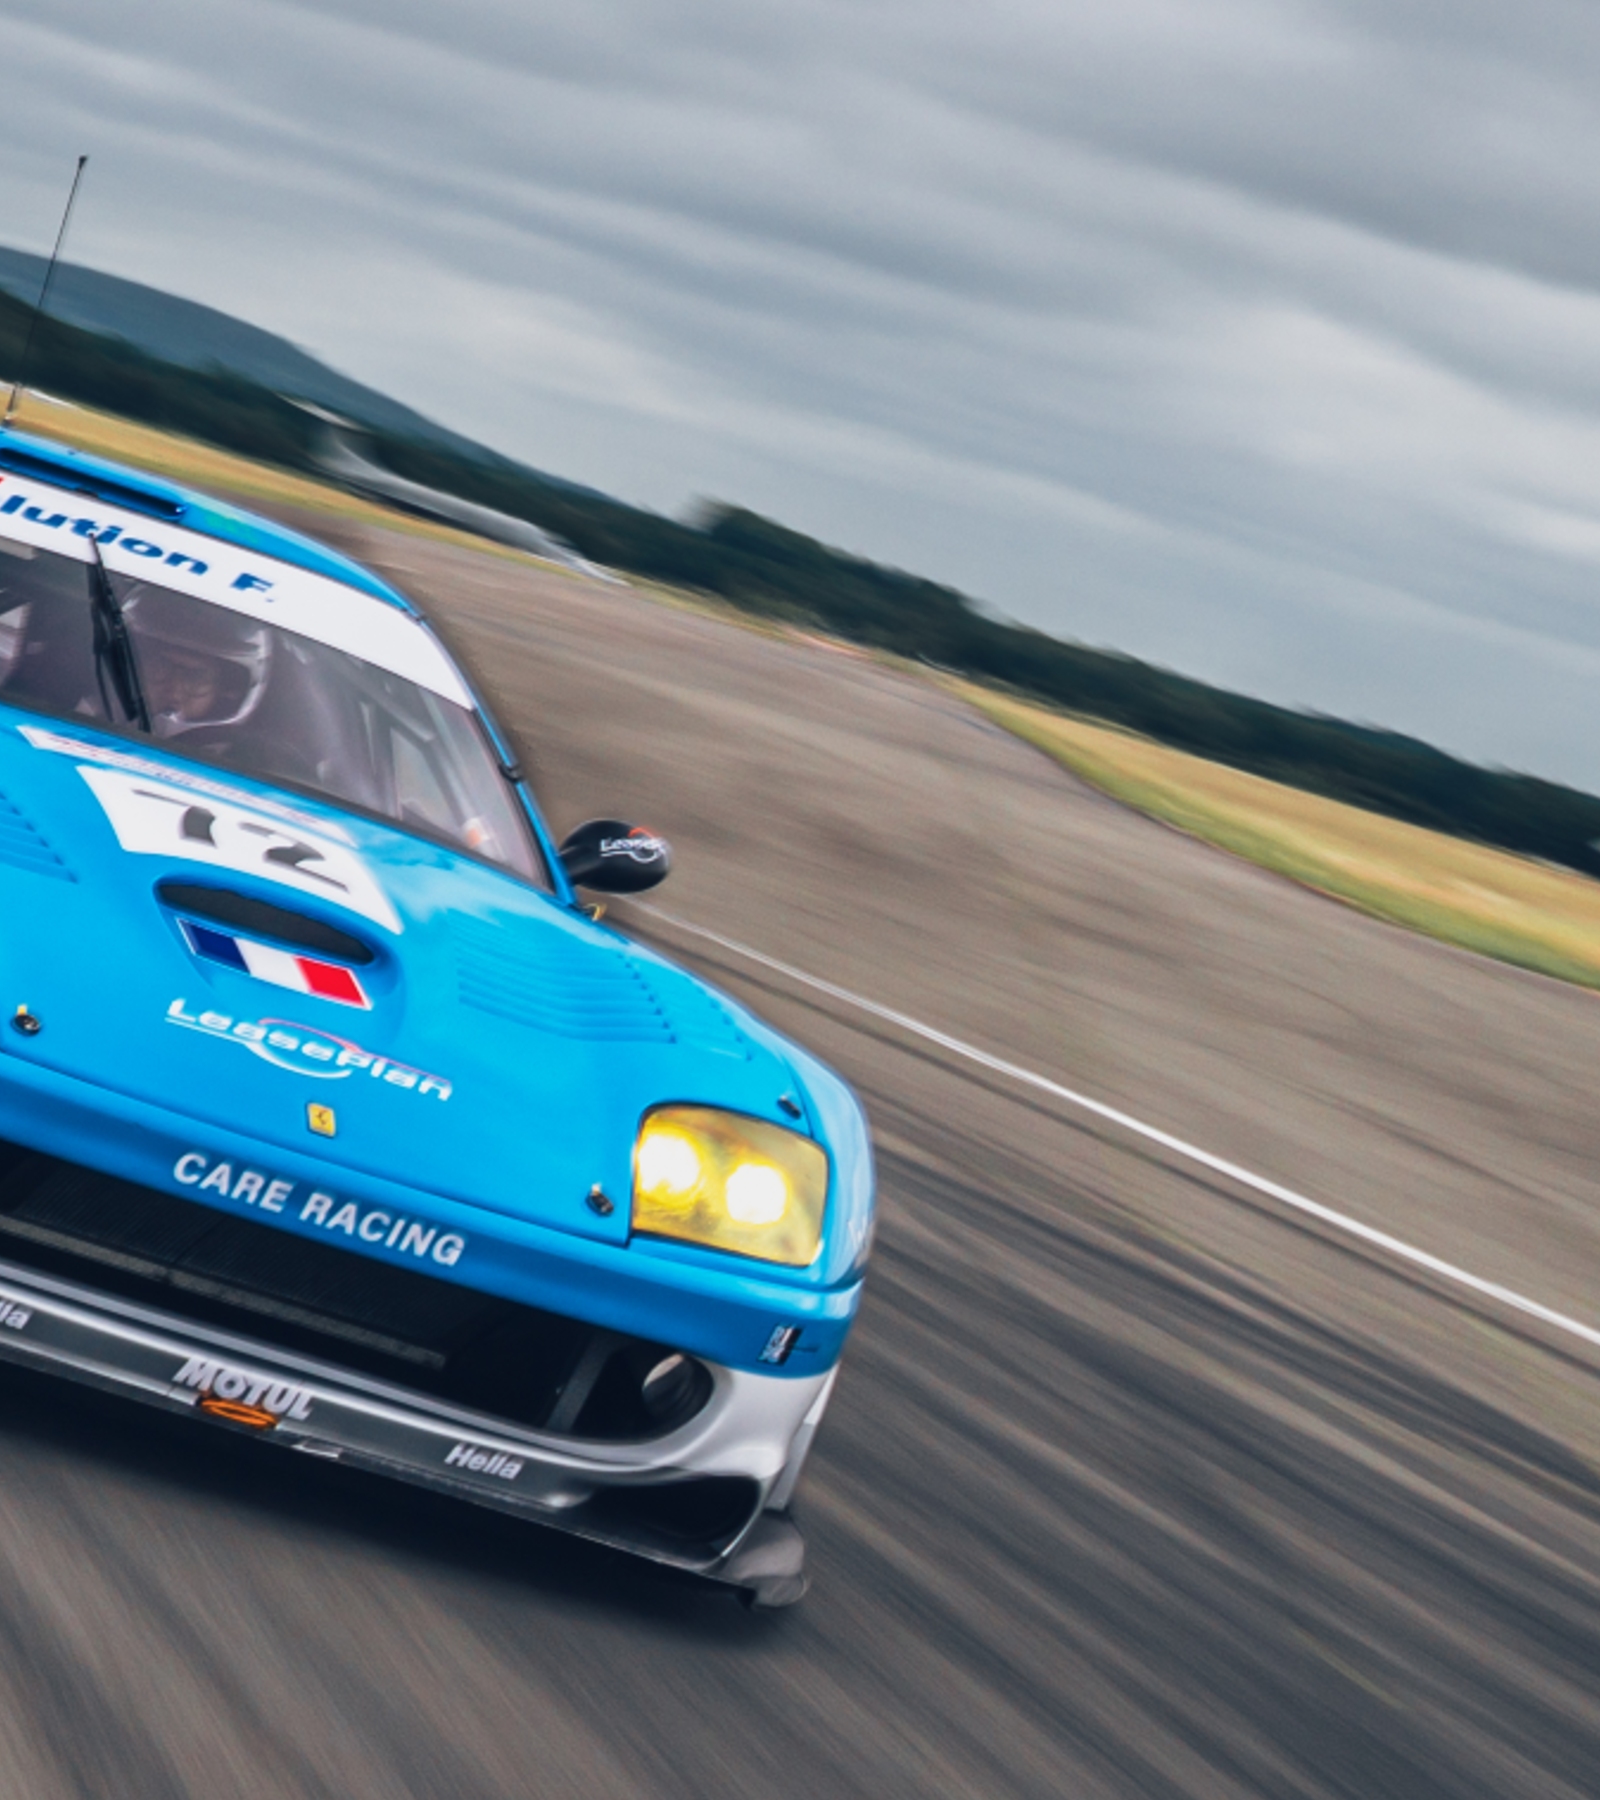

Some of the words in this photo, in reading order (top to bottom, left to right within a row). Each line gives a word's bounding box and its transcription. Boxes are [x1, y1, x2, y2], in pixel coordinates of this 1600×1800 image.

[131, 787, 351, 893] 72
[165, 998, 453, 1101] Leaseplan
[173, 1152, 294, 1214] CARE
[299, 1191, 466, 1267] RACING
[172, 1354, 315, 1421] MOTUL
[443, 1442, 525, 1482] Hella
